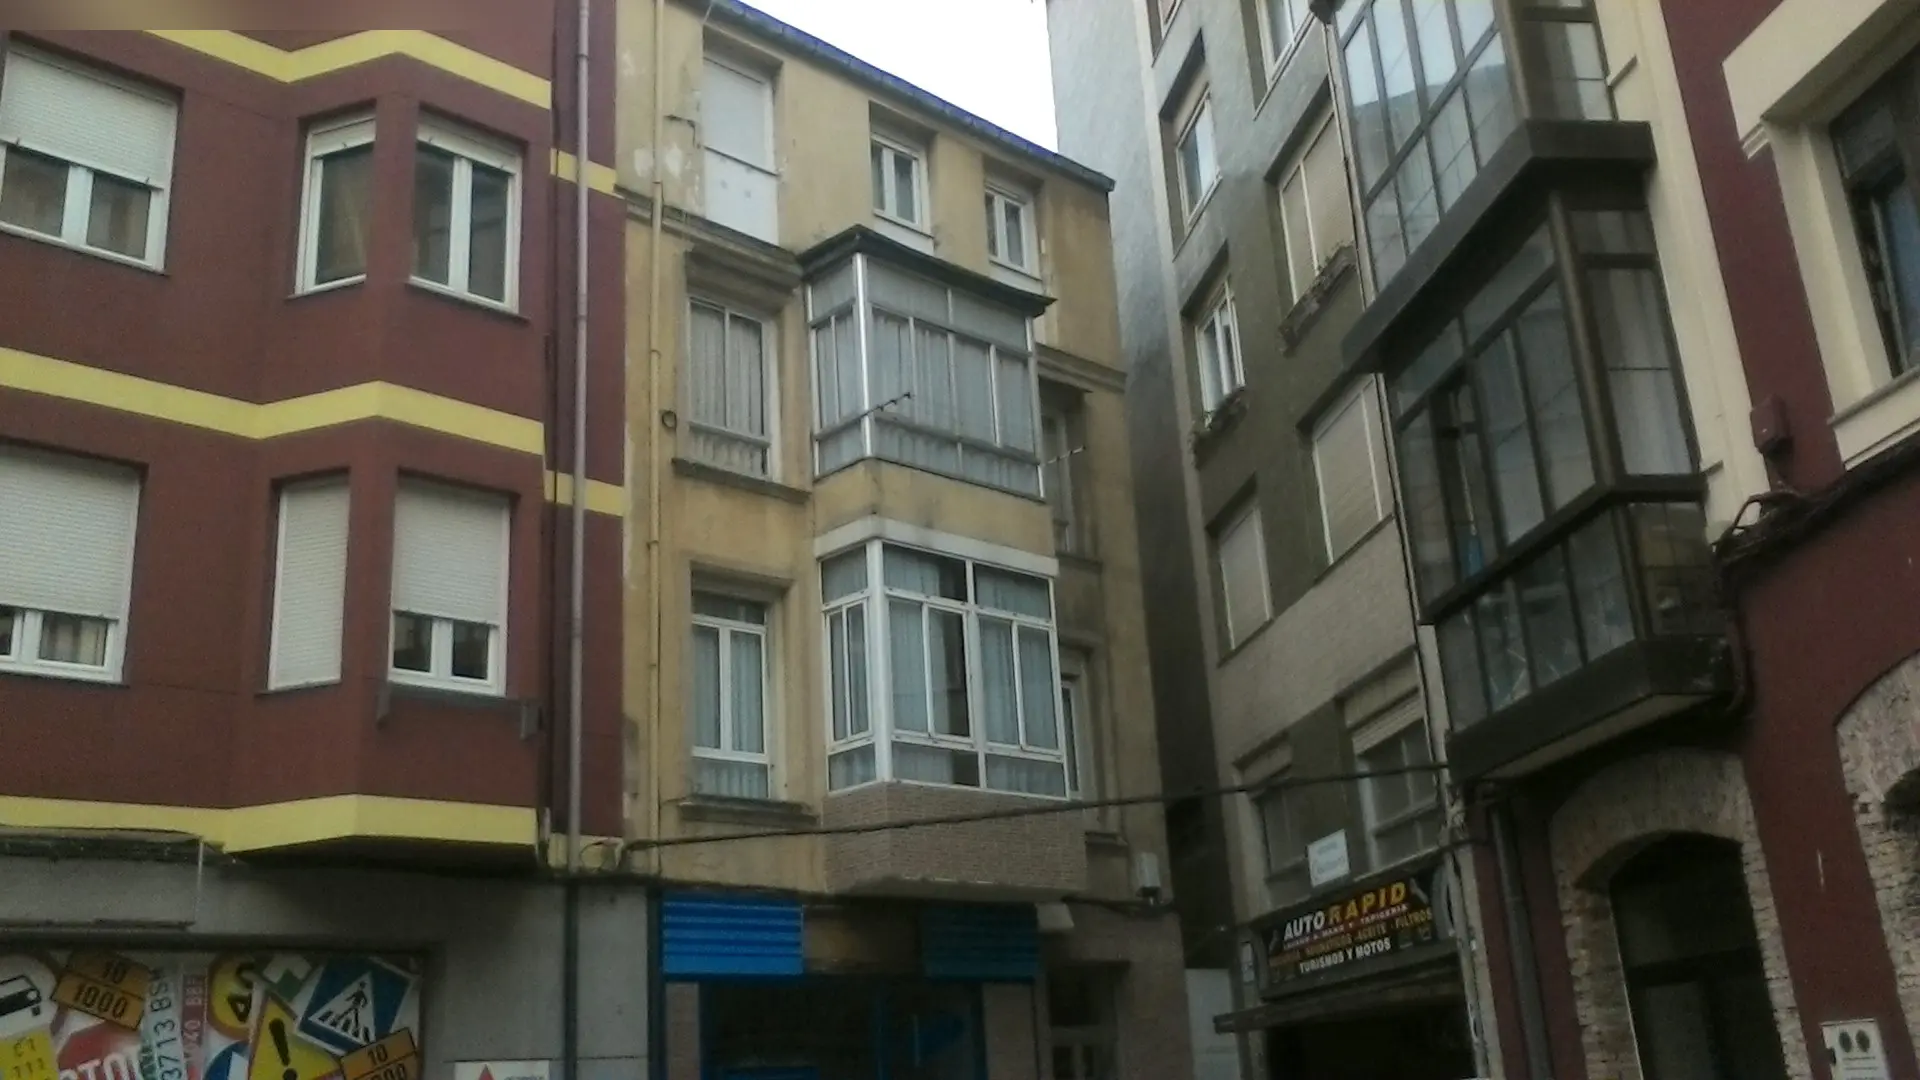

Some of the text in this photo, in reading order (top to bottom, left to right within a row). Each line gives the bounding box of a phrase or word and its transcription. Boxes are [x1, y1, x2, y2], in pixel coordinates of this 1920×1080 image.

[1283, 881, 1406, 941] AUTO RAPID
[102, 960, 130, 984] 10
[1300, 950, 1345, 974] TURISMOS
[1355, 936, 1392, 960] MOTOS
[73, 982, 128, 1019] 1000
[368, 1044, 388, 1065] 10
